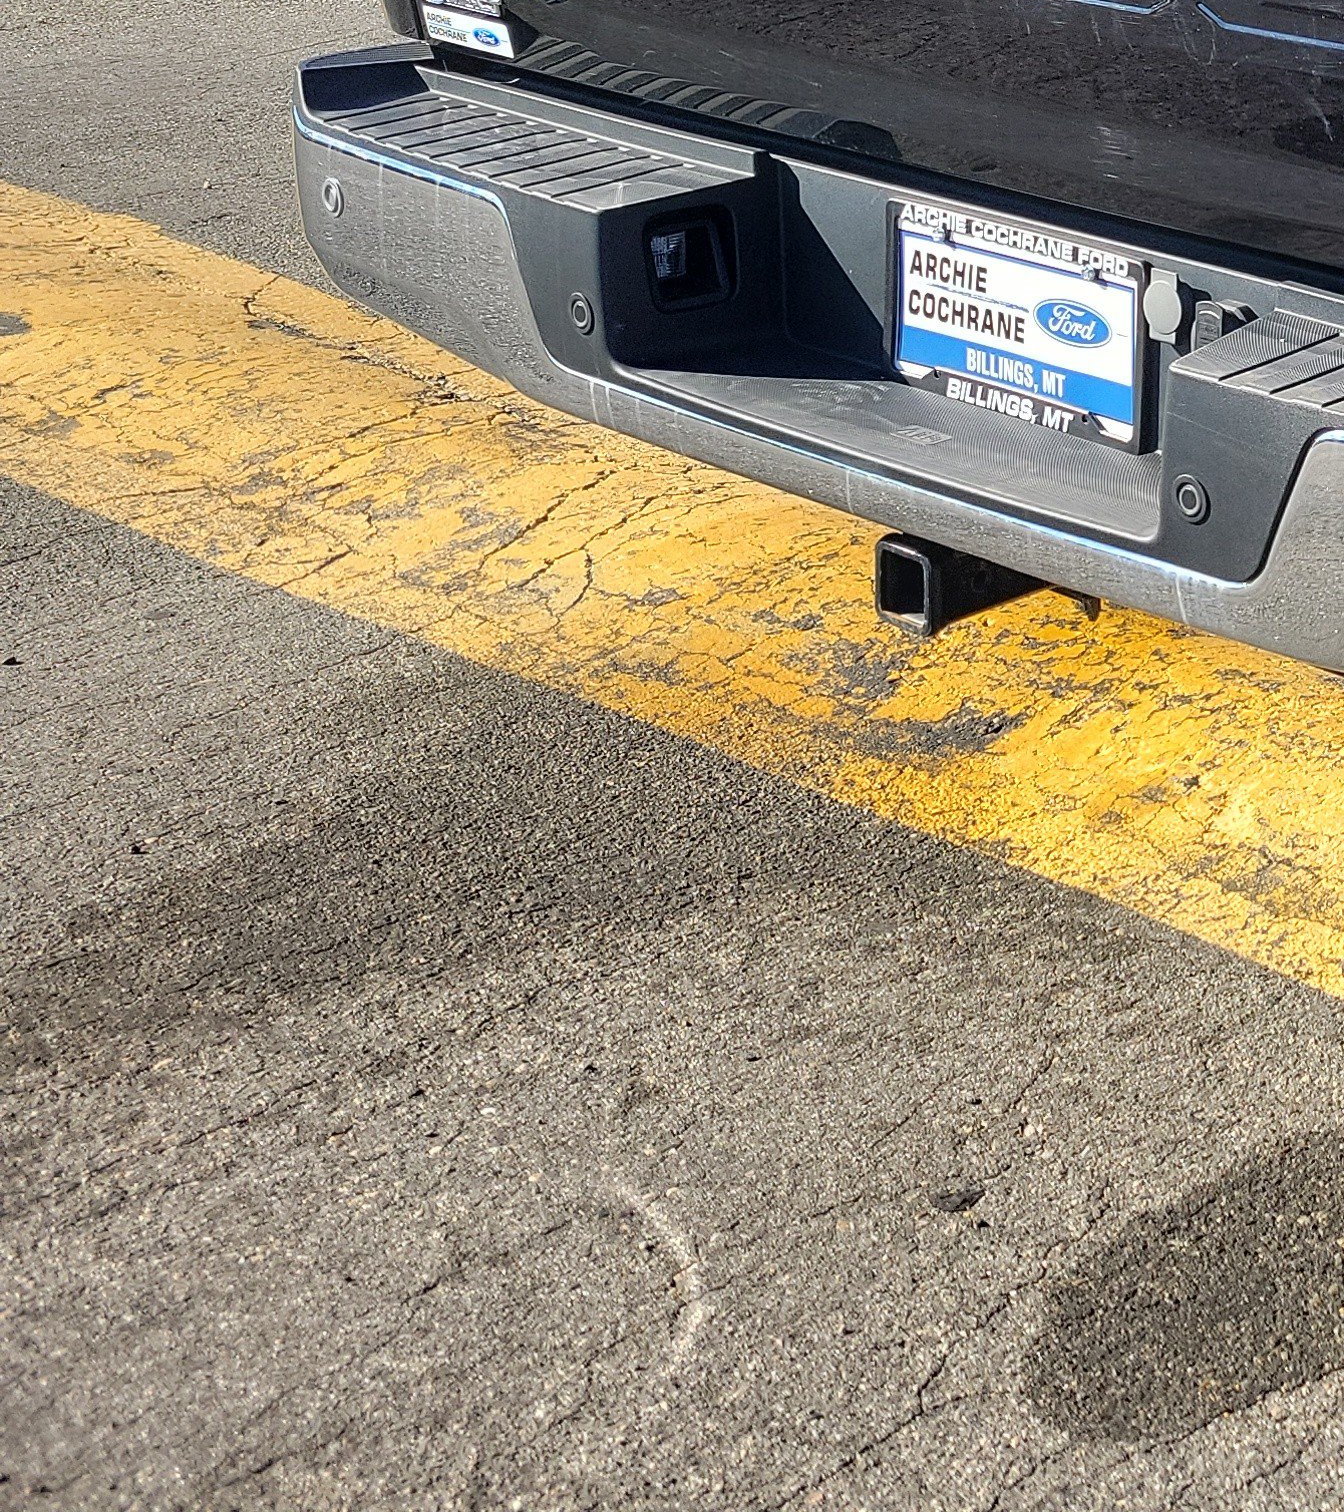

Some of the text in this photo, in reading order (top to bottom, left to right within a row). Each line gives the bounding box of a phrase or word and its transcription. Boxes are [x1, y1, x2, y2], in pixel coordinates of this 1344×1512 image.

[426, 10, 452, 27] ARCHIE
[429, 26, 468, 43] COCHRANE
[900, 203, 1129, 278] ARCHIE COCHRANE FORD
[909, 249, 988, 294] ARCHIE
[908, 289, 1026, 344] COCHRANE
[1048, 304, 1096, 341] Ford
[966, 347, 1067, 399] BILLINGS, MT
[946, 377, 1075, 434] BILLINGS, MT
